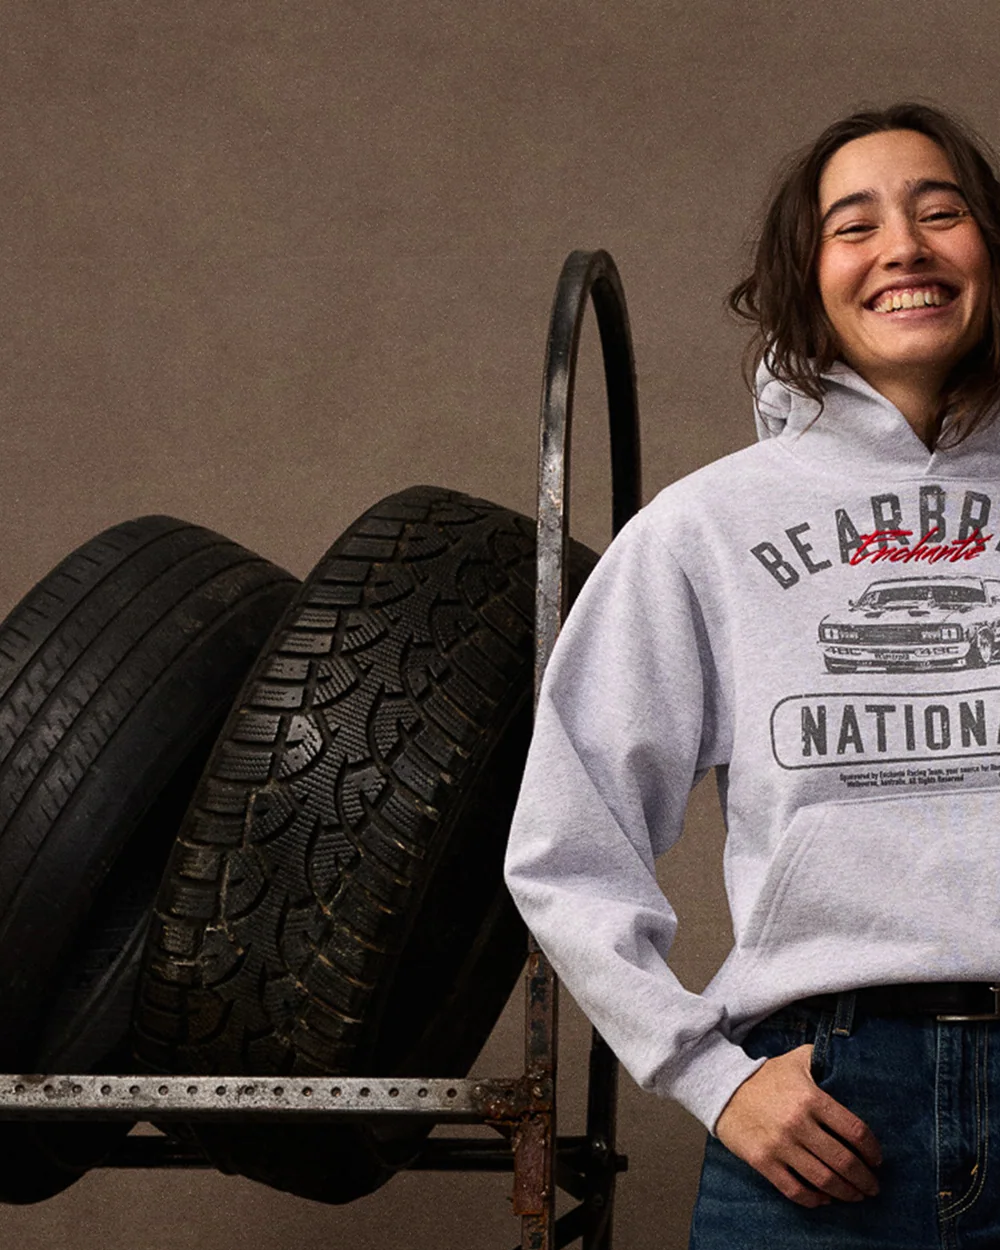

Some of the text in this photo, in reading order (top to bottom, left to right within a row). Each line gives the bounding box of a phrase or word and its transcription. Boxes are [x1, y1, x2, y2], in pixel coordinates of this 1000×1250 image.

[907, 768, 926, 777] Racing
[918, 776, 936, 786] Rights
[938, 773, 964, 783] Reserved
